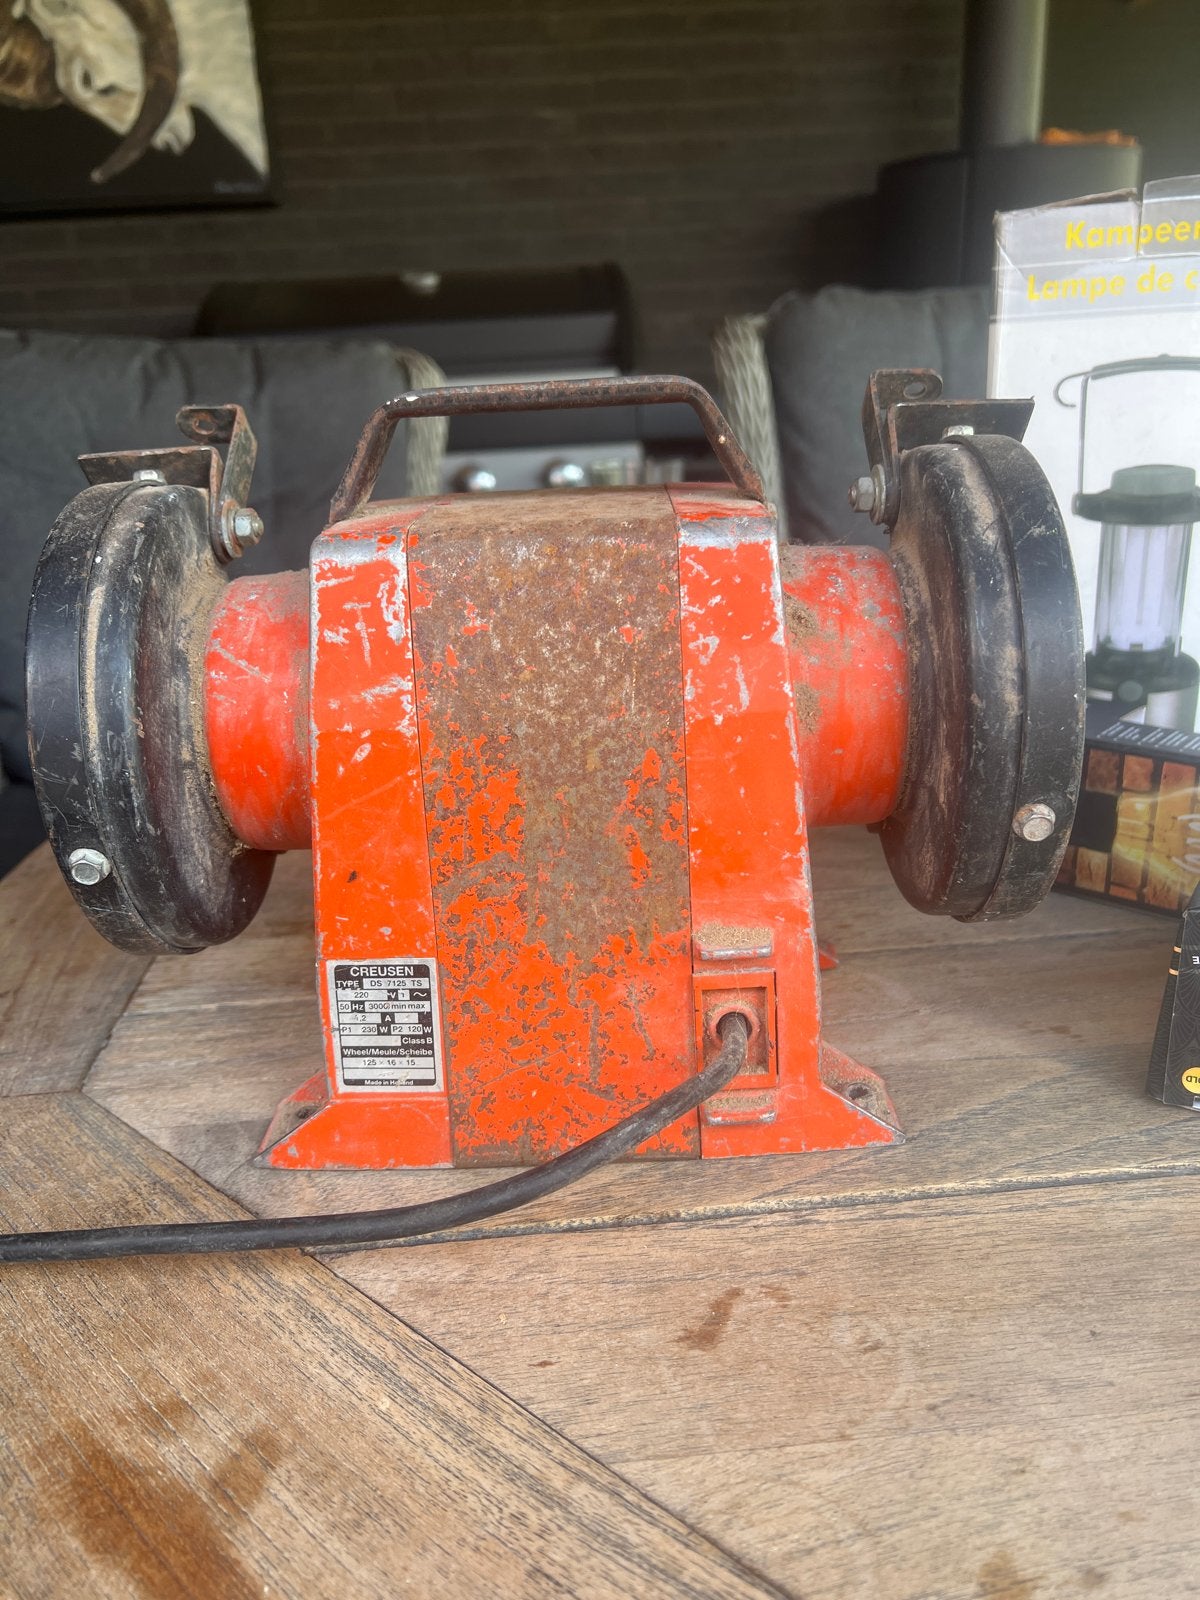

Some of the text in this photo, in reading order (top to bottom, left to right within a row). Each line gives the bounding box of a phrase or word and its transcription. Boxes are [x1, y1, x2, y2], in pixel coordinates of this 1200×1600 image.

[1026, 273, 1127, 304] Lampe
[1136, 263, 1175, 295] de
[350, 966, 414, 977] CREUSEN
[336, 980, 360, 988] TYPE
